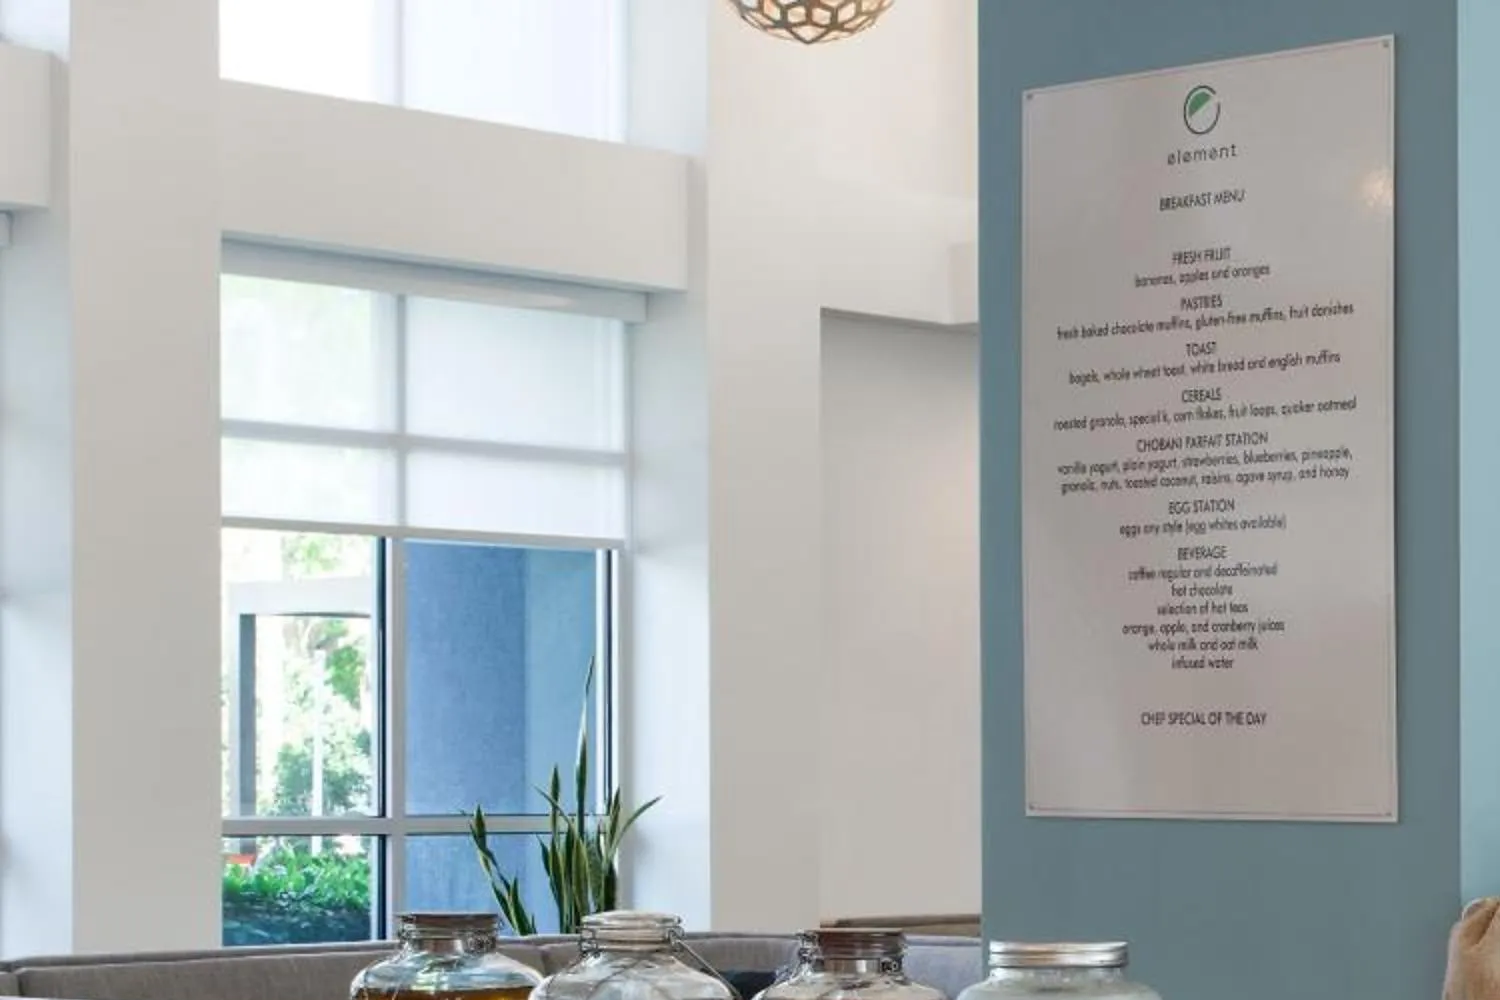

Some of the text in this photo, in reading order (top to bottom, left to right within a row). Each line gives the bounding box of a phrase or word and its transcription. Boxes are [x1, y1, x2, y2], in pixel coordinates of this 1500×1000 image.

[1167, 144, 1238, 165] element
[1159, 188, 1246, 211] BREAKFAST MENU
[1172, 247, 1231, 265] FRESH FRUIT
[1179, 268, 1209, 285] apples
[1211, 266, 1230, 279] and
[1231, 264, 1270, 280] oranges
[1181, 294, 1223, 311] PASTRIES
[1057, 325, 1079, 341] fresh
[1081, 323, 1109, 339] baked
[1111, 320, 1155, 336] chocolate
[1289, 304, 1309, 319] fruit
[1311, 300, 1354, 317] danishes
[1186, 341, 1217, 356] TOAST
[1103, 368, 1130, 381] whole
[1132, 365, 1161, 379] wheat
[1190, 360, 1215, 374] white
[1218, 356, 1244, 372] bread
[1247, 356, 1266, 371] and
[1268, 352, 1302, 371] english
[1305, 350, 1340, 366] muffins
[1182, 387, 1222, 403] CEREALS
[1053, 415, 1087, 432] roasted
[1173, 411, 1194, 423] corn
[1229, 404, 1248, 419] fruit
[1317, 395, 1357, 412] oatmeal
[1136, 431, 1269, 453] CHOBANI PARFAIT STATION
[1057, 460, 1087, 475] vanilla
[1124, 476, 1158, 489] toasted
[1235, 471, 1264, 487] agave
[1298, 466, 1317, 480] and
[1319, 464, 1349, 480] honey
[1168, 499, 1235, 515] EGG STATION
[1119, 524, 1141, 538] eggs
[1143, 523, 1160, 536] any
[1162, 519, 1183, 535] style
[1209, 517, 1239, 531] whites
[1177, 546, 1228, 561] BEVERAGE
[1128, 561, 1278, 583] coffee regular and decaffeinated
[1171, 581, 1233, 597] hot chocolate
[1157, 601, 1249, 616] selection of hot teas
[1191, 620, 1209, 633] and
[1211, 619, 1256, 633] cranberry
[1257, 618, 1285, 634] juices
[1148, 636, 1259, 651] whole milk and oat milk
[1171, 655, 1234, 669] infused water
[1140, 711, 1267, 726] CHEF SPECIAL OF THE DAY
